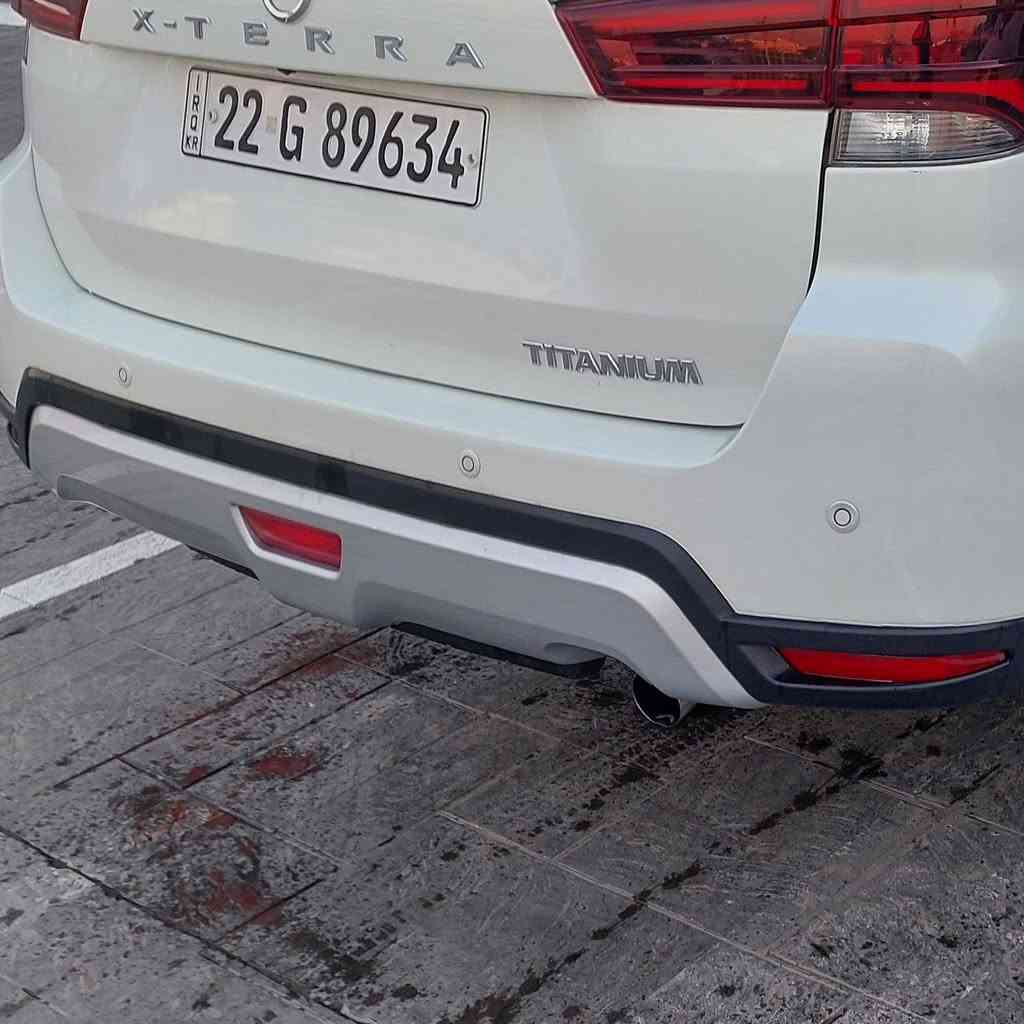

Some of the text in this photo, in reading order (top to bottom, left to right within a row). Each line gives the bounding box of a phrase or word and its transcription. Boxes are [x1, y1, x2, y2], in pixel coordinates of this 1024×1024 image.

[131, 7, 486, 70] X-TERRA
[213, 85, 466, 189] 22 G 89634
[521, 339, 704, 386] TITANIUM
